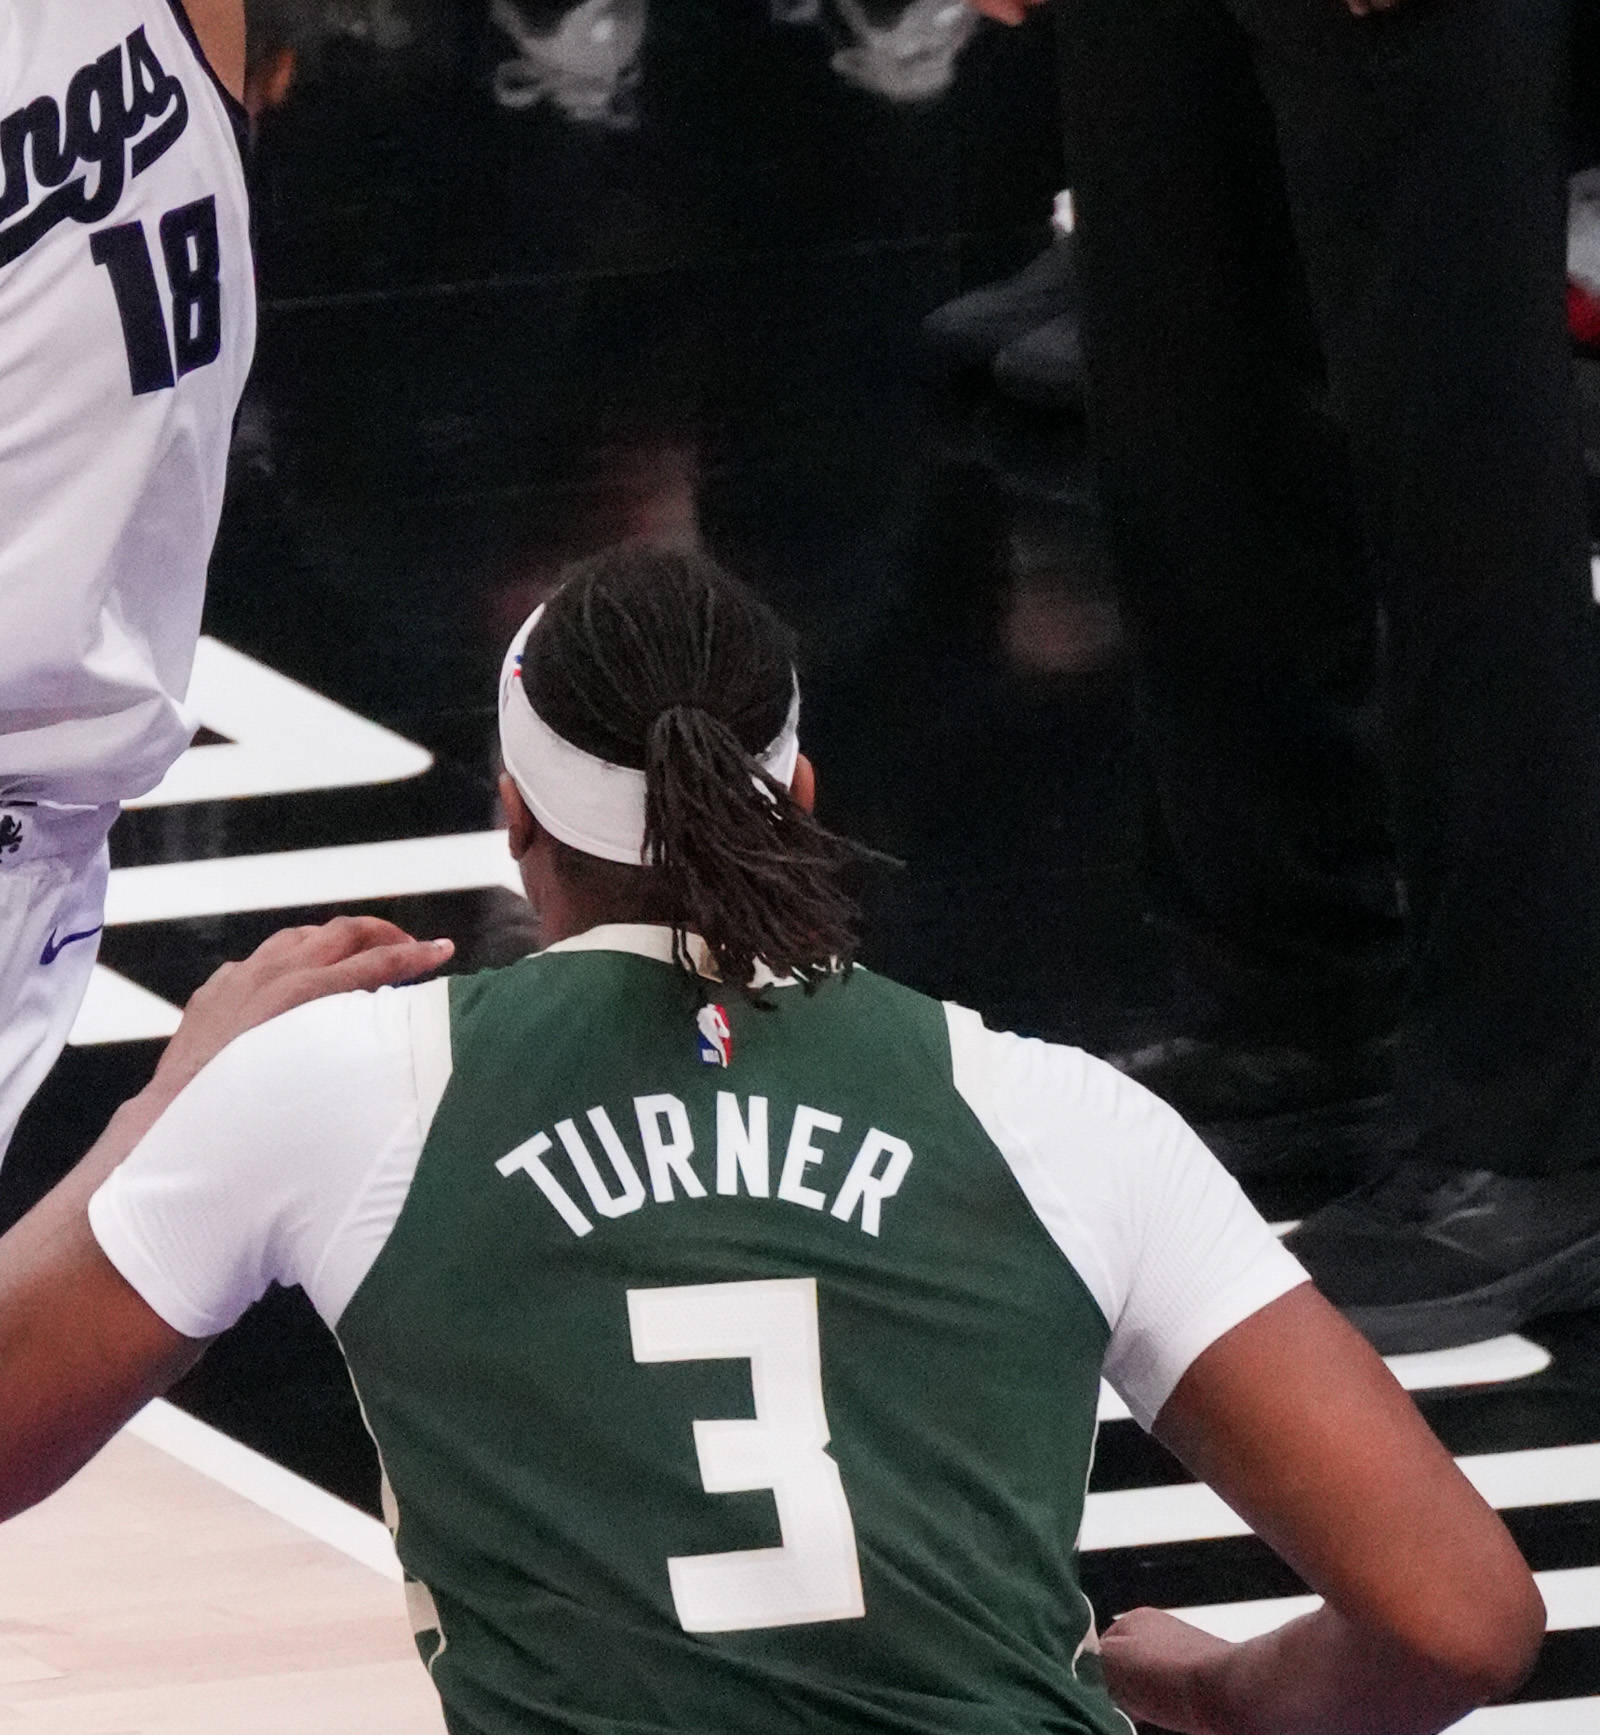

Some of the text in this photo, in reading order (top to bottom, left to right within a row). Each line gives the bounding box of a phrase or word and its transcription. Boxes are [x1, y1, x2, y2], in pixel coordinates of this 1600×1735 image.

[89, 194, 221, 397] 18
[495, 1090, 914, 1238] TURNER
[626, 1277, 867, 1633] 3
